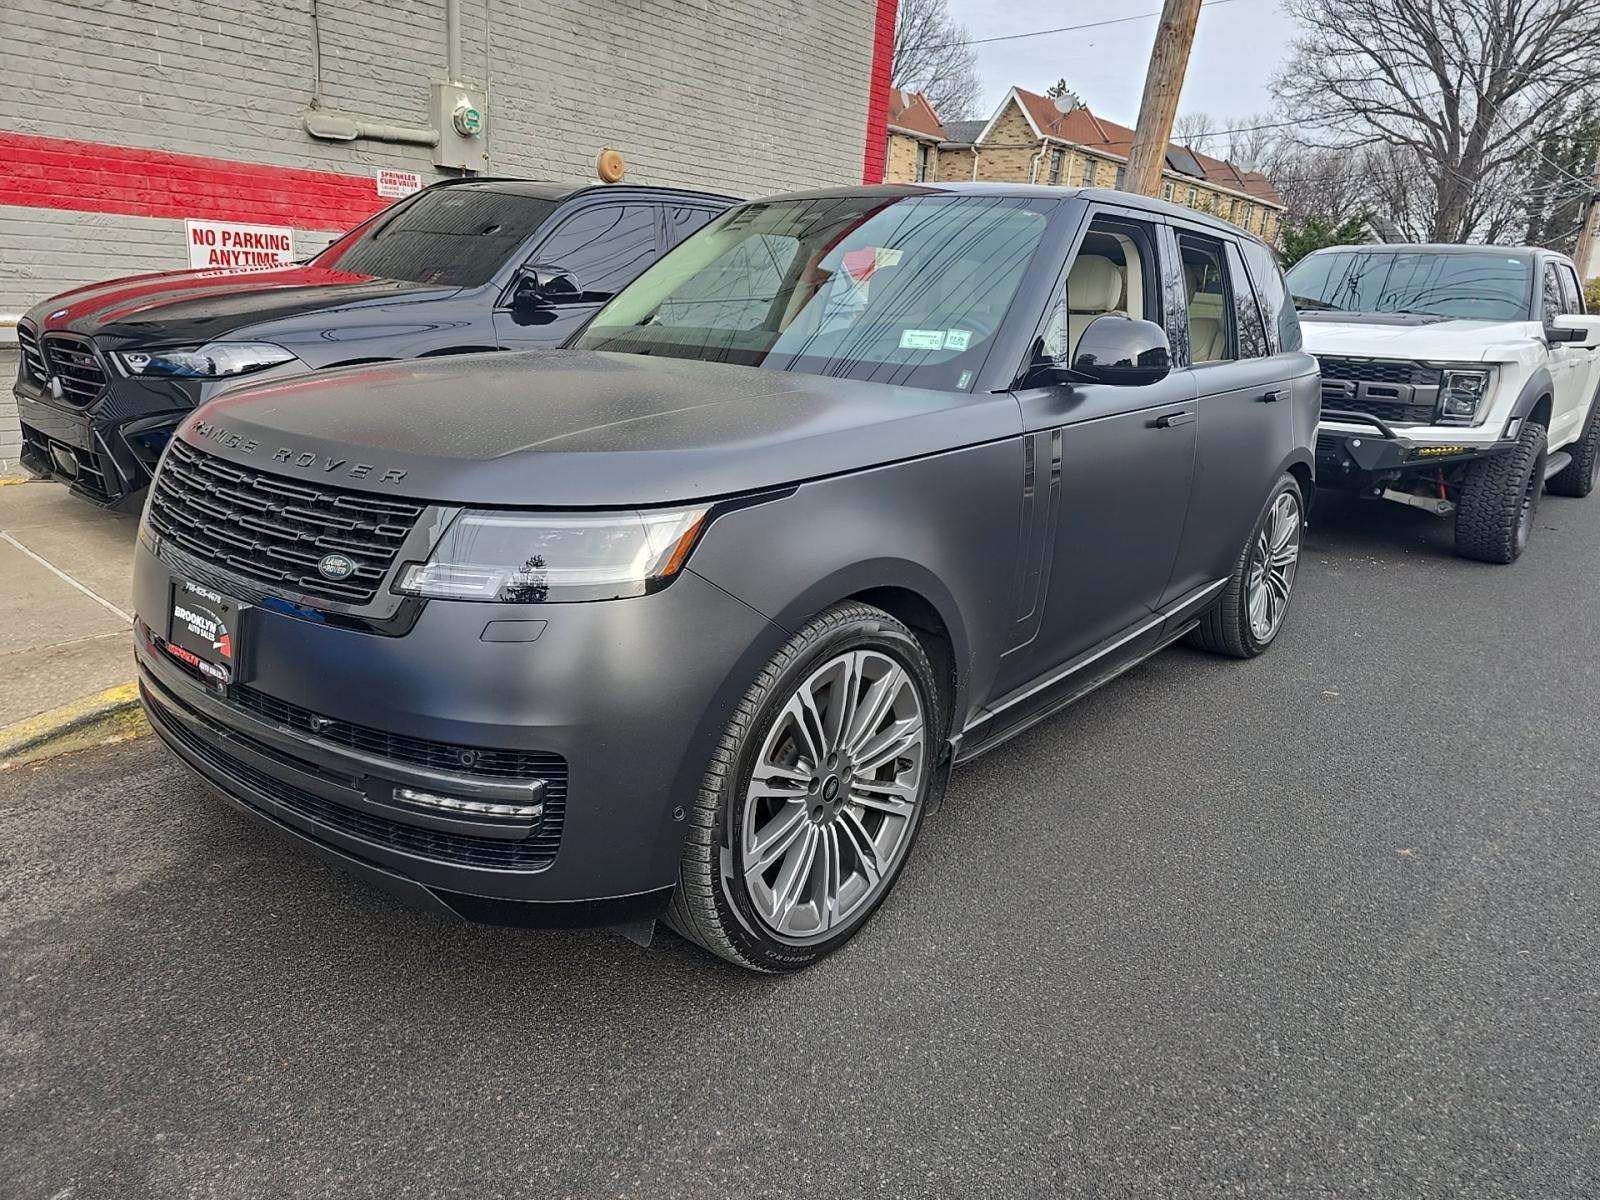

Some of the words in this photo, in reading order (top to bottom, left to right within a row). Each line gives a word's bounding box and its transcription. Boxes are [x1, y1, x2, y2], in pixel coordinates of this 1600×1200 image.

[380, 178, 398, 186] CURB
[398, 180, 418, 188] VALVE
[381, 171, 416, 181] SPRINKLER
[192, 229, 216, 246] NO
[221, 231, 290, 251] PARKING
[209, 249, 279, 267] ANYTIME
[192, 420, 262, 456] RANGE
[272, 447, 409, 485] ROVER
[323, 564, 347, 575] ROVER
[325, 557, 344, 567] LAND
[174, 605, 217, 634] BROOKLYN
[188, 622, 201, 635] AUTO
[200, 628, 216, 642] SALES
